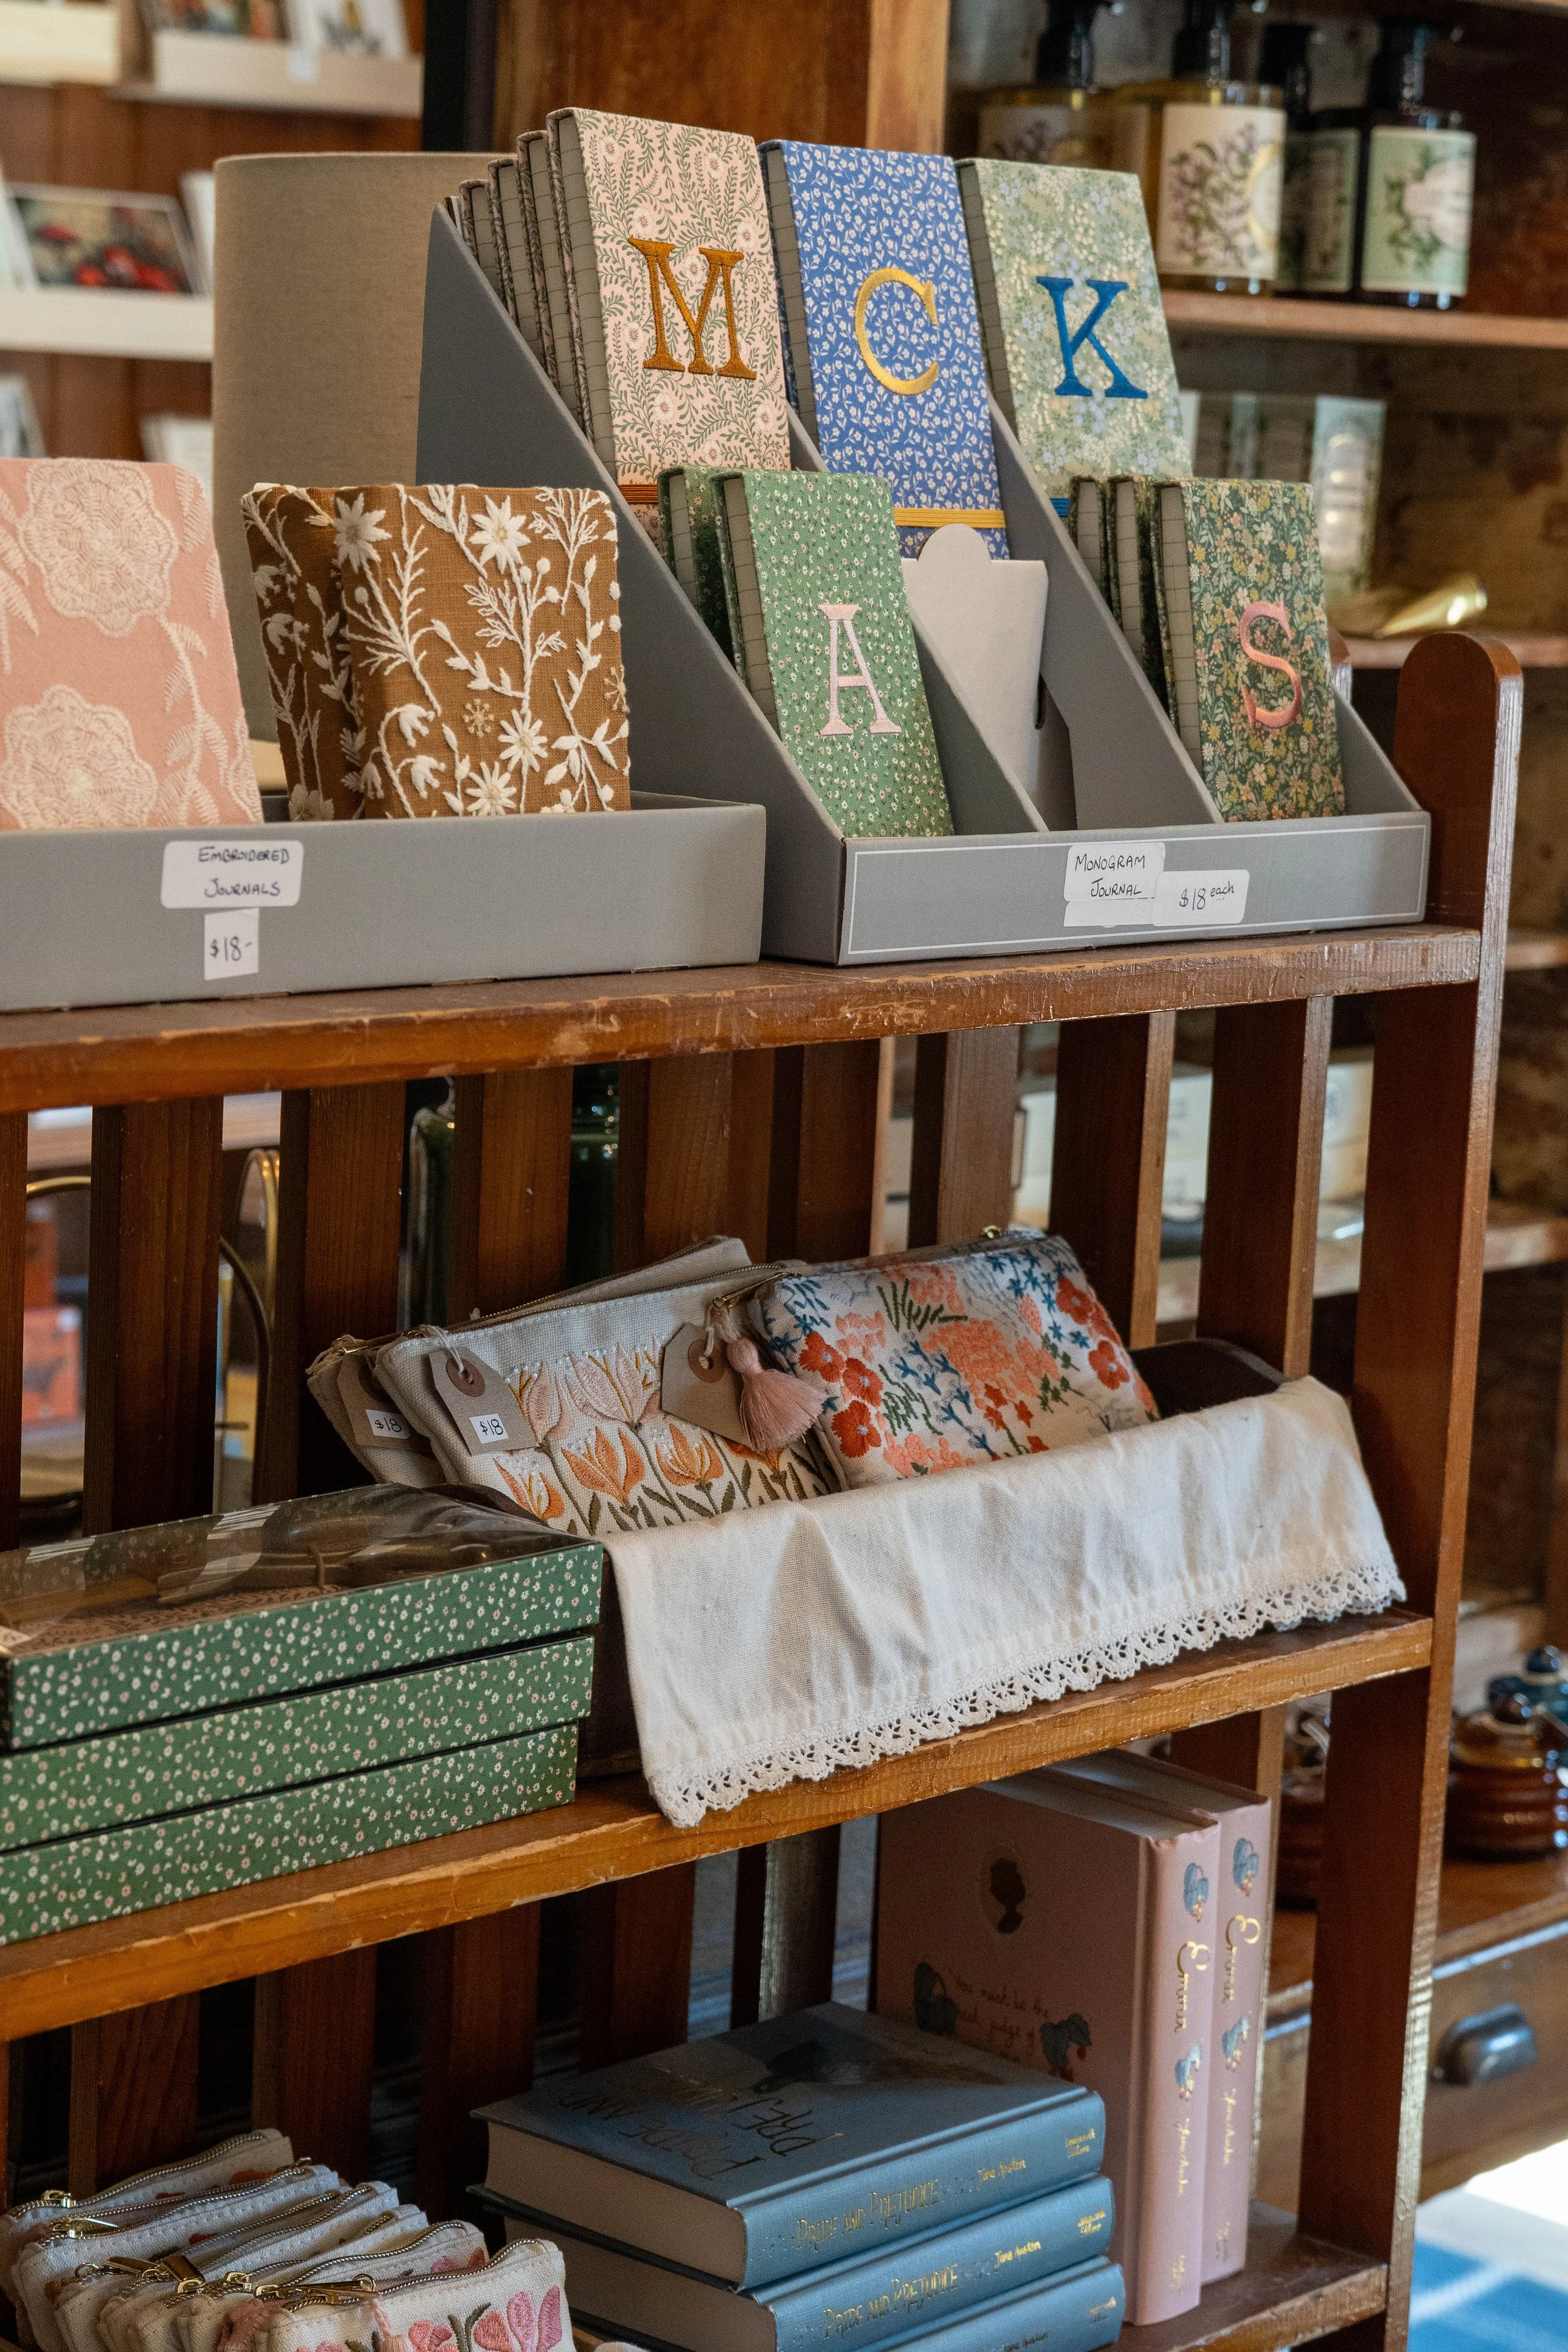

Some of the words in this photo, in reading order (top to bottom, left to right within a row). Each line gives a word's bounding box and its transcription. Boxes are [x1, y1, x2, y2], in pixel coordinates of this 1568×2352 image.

[628, 236, 756, 379] M
[854, 267, 938, 395] C
[1036, 276, 1147, 398] K
[817, 603, 901, 737] A
[1239, 601, 1302, 729] S
[204, 879, 280, 898] JOURNALS
[1074, 854, 1145, 872] MONOGRAM
[1091, 877, 1142, 897] JOURNAL
[1179, 887, 1206, 911] $18
[1210, 881, 1234, 896] each
[374, 1417, 401, 1433] $18
[480, 1419, 503, 1436] $18
[1174, 1941, 1210, 2034] Emma
[1222, 1914, 1261, 2005] Emma
[796, 2216, 837, 2253] PRIDE
[844, 2208, 866, 2233] AND
[824, 2304, 863, 2340] PRIDE
[867, 2295, 891, 2323] AND
[994, 2250, 1013, 2269] Jane
